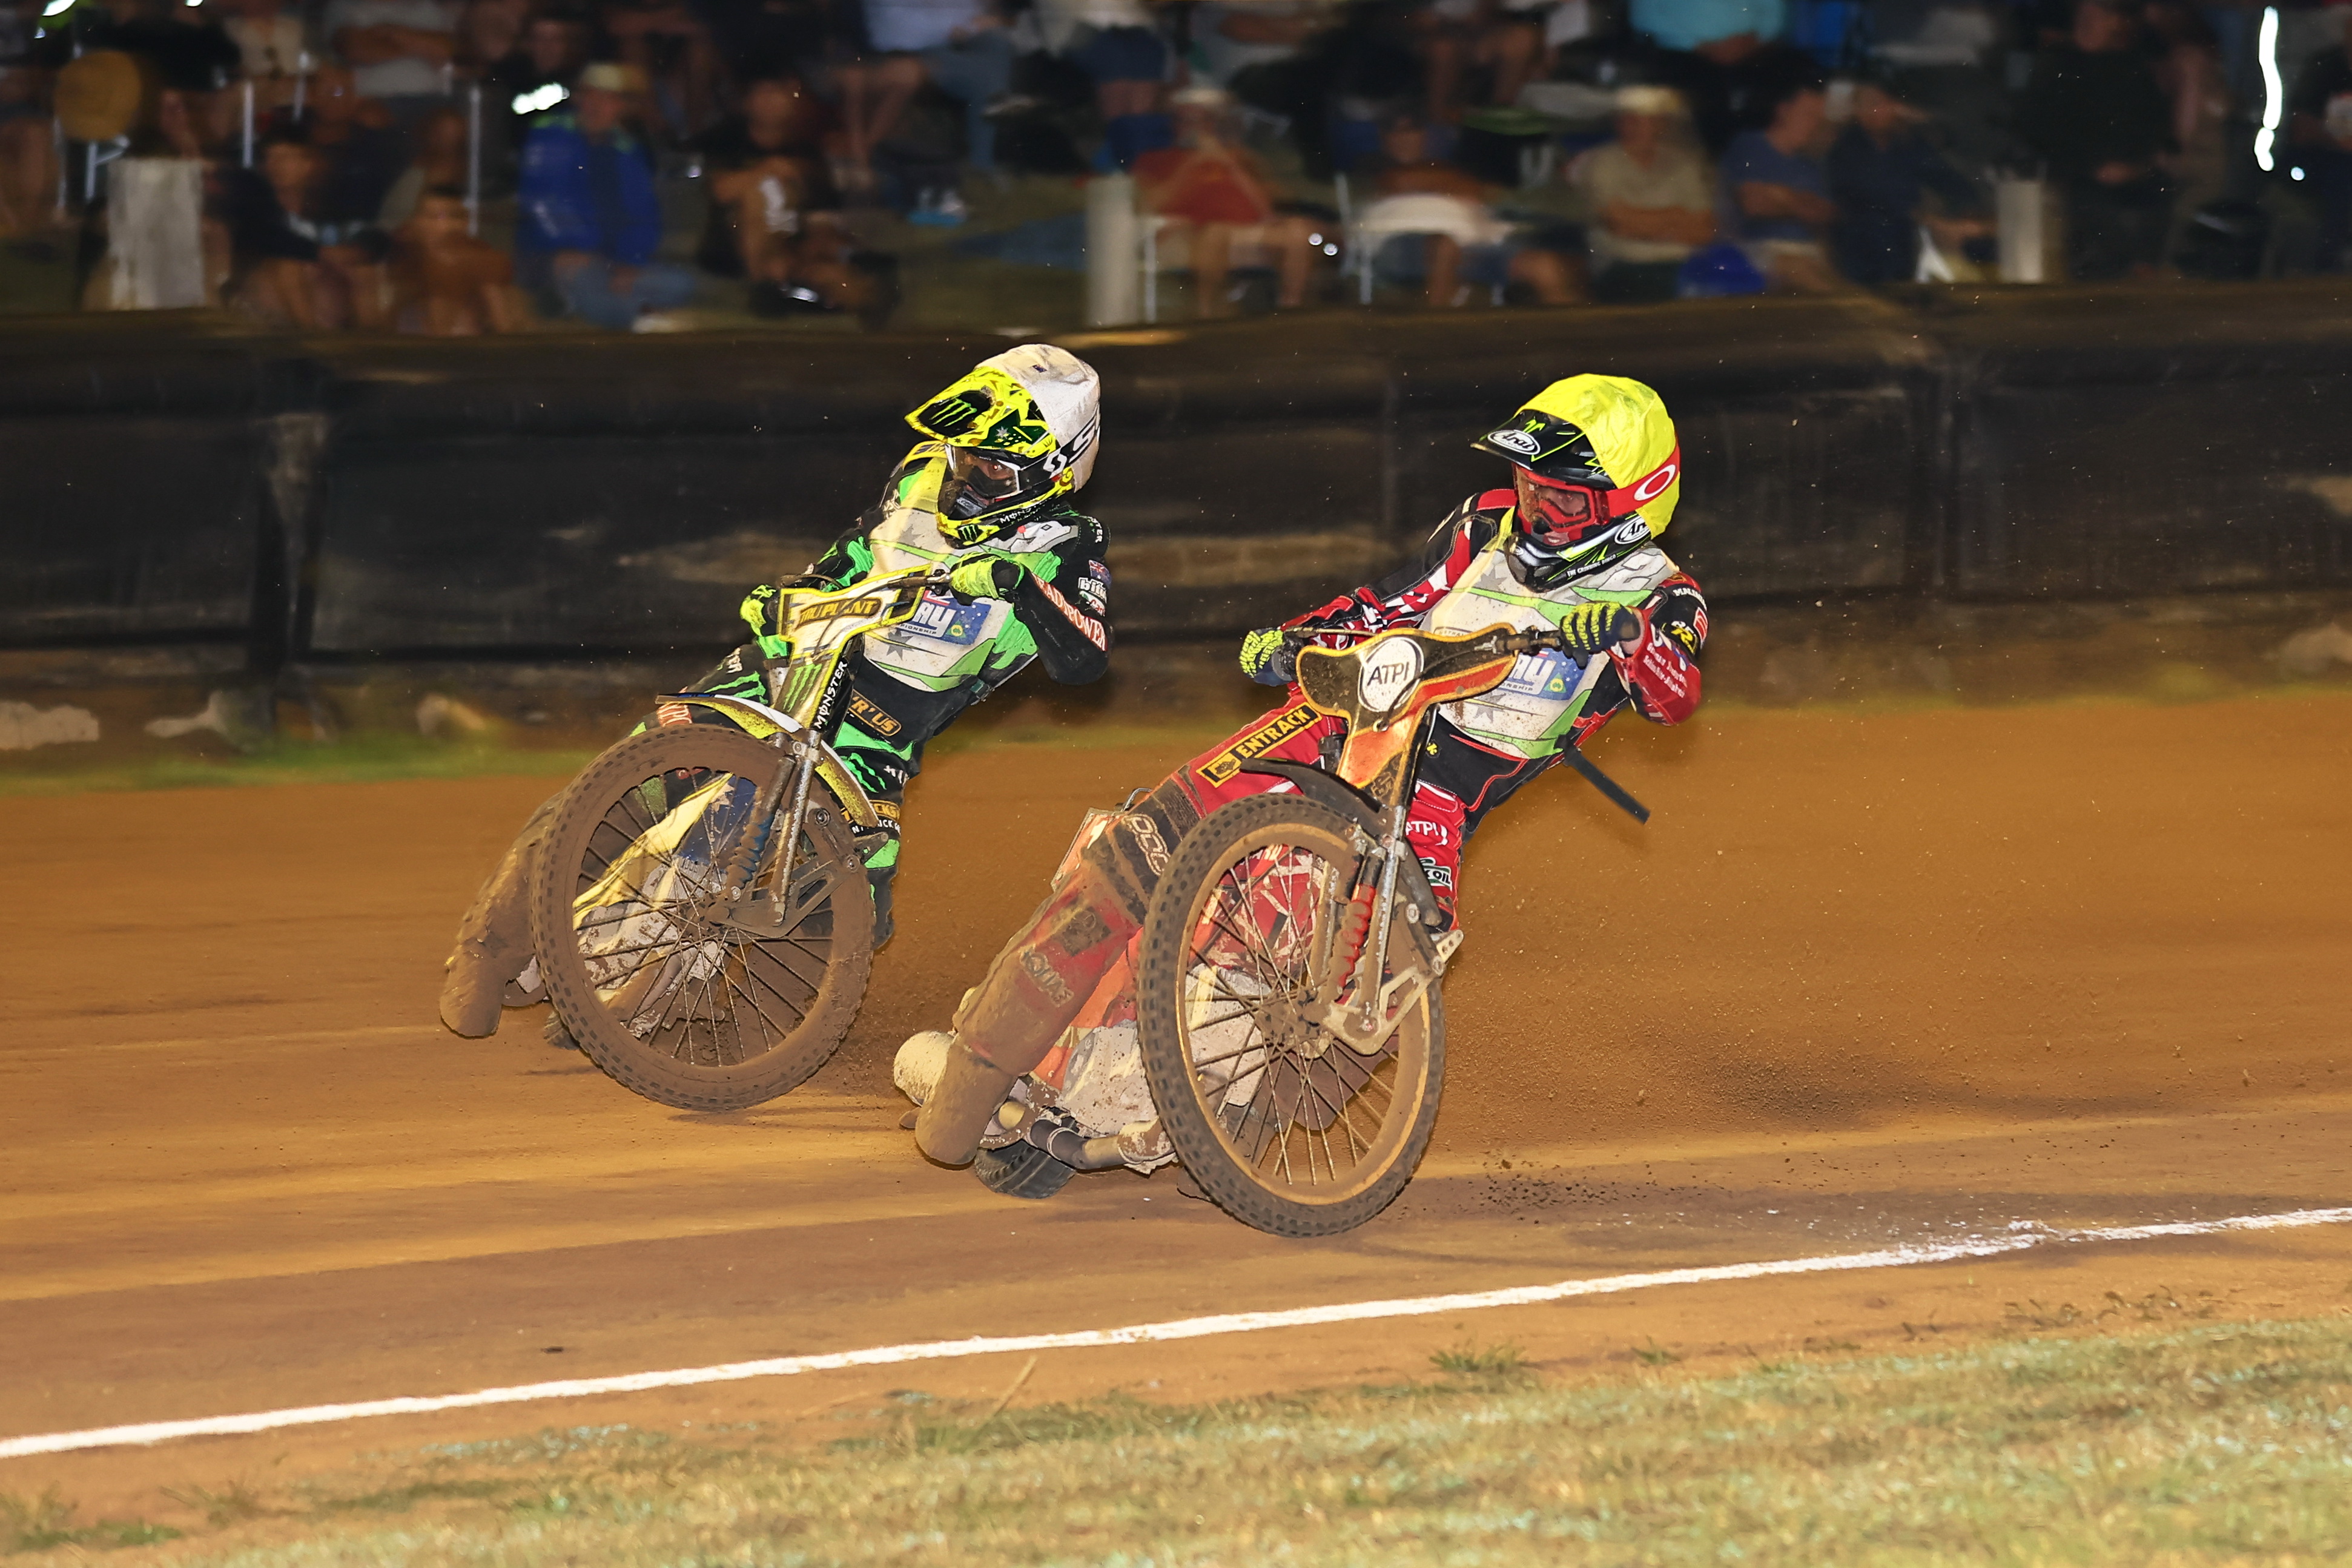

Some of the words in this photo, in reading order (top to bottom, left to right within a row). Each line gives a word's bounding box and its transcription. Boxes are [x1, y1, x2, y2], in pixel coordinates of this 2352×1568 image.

[900, 623, 937, 636] PIONSHIP
[1367, 662, 1410, 687] ATPI
[814, 661, 848, 729] MONSTER
[871, 711, 897, 732] US
[1235, 708, 1311, 759] ENTRACK
[1432, 870, 1451, 884] OIL
